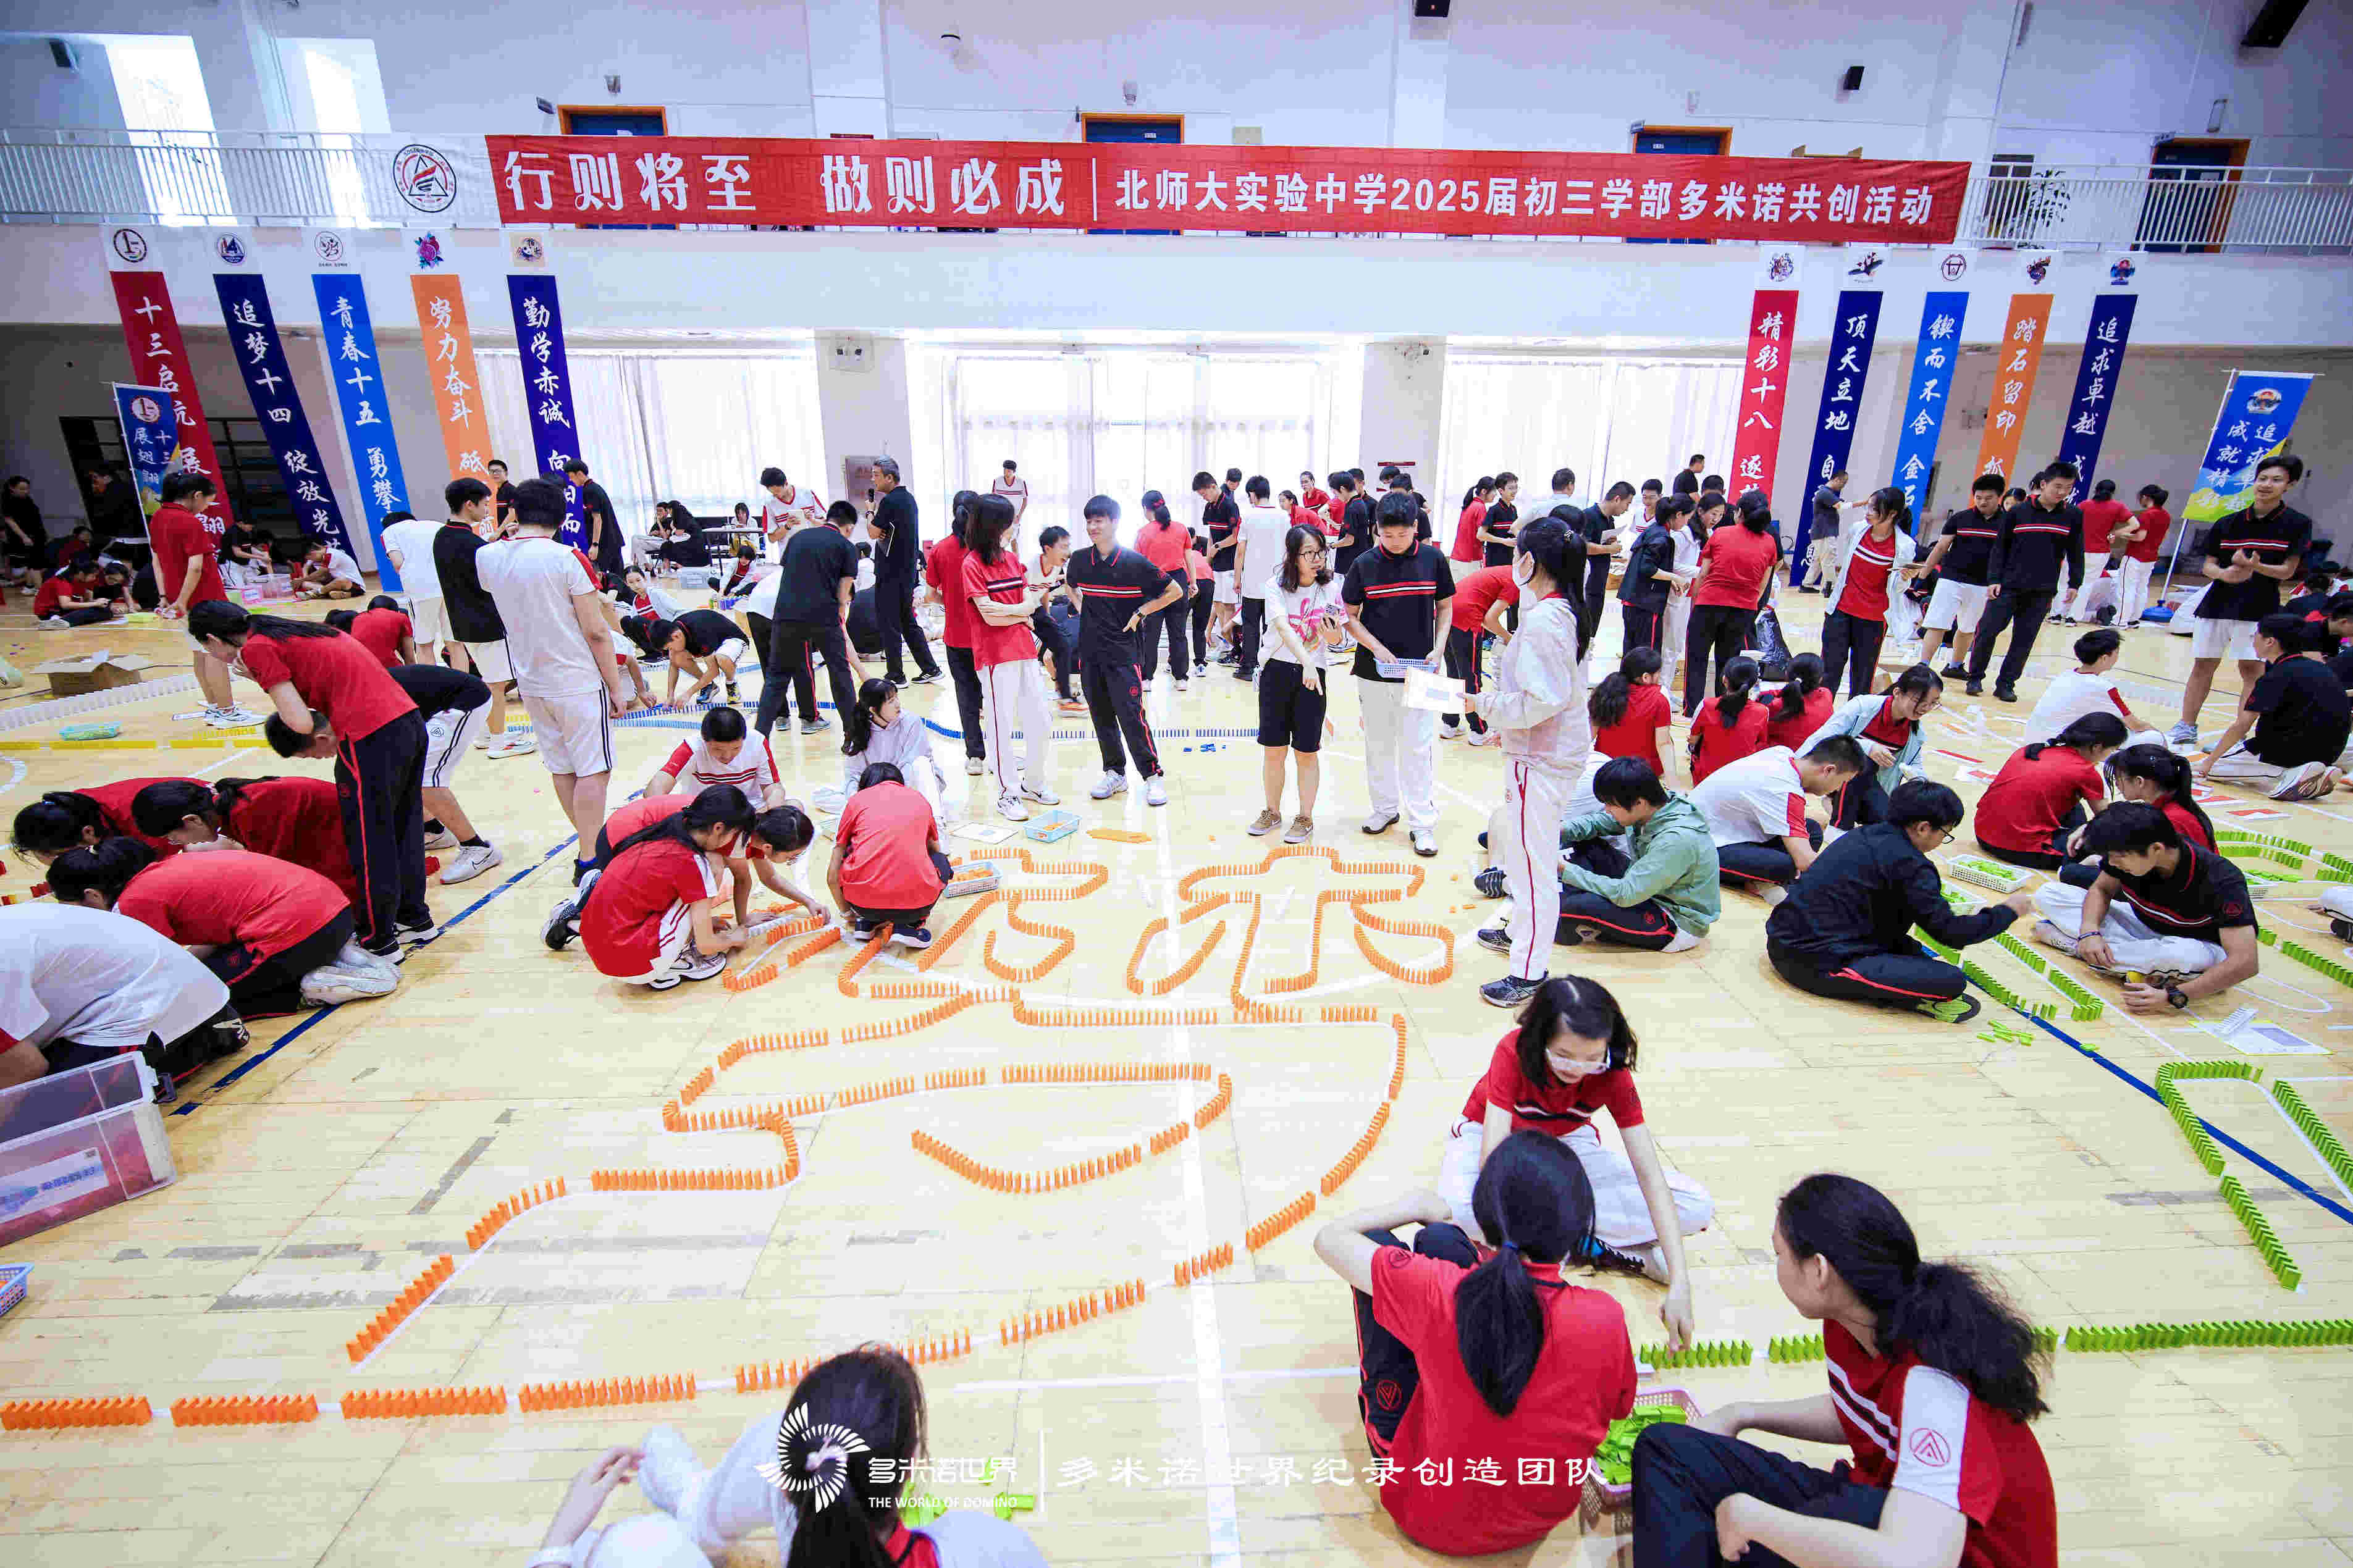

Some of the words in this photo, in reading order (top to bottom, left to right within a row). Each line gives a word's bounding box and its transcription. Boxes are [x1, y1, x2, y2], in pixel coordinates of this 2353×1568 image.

[504, 153, 756, 211] 行则将至
[821, 154, 1064, 216] 做则必成
[1116, 170, 1932, 225] 北师大实验中学2025届初三学部多米诺共创活动
[233, 298, 292, 424] 追梦十四
[330, 296, 382, 426] 青春十五
[367, 447, 402, 519] 勇攀
[429, 296, 473, 430] 努力奋斗
[523, 296, 571, 429] 勤学赤诚
[1744, 311, 1784, 429] 精彩十八
[1824, 313, 1868, 430] 顶天立地
[1908, 314, 1955, 435] 锲而不舍
[1996, 317, 2037, 439] 踏石留印
[2071, 316, 2120, 435] 追求卓越
[133, 426, 163, 499] 展翅翱
